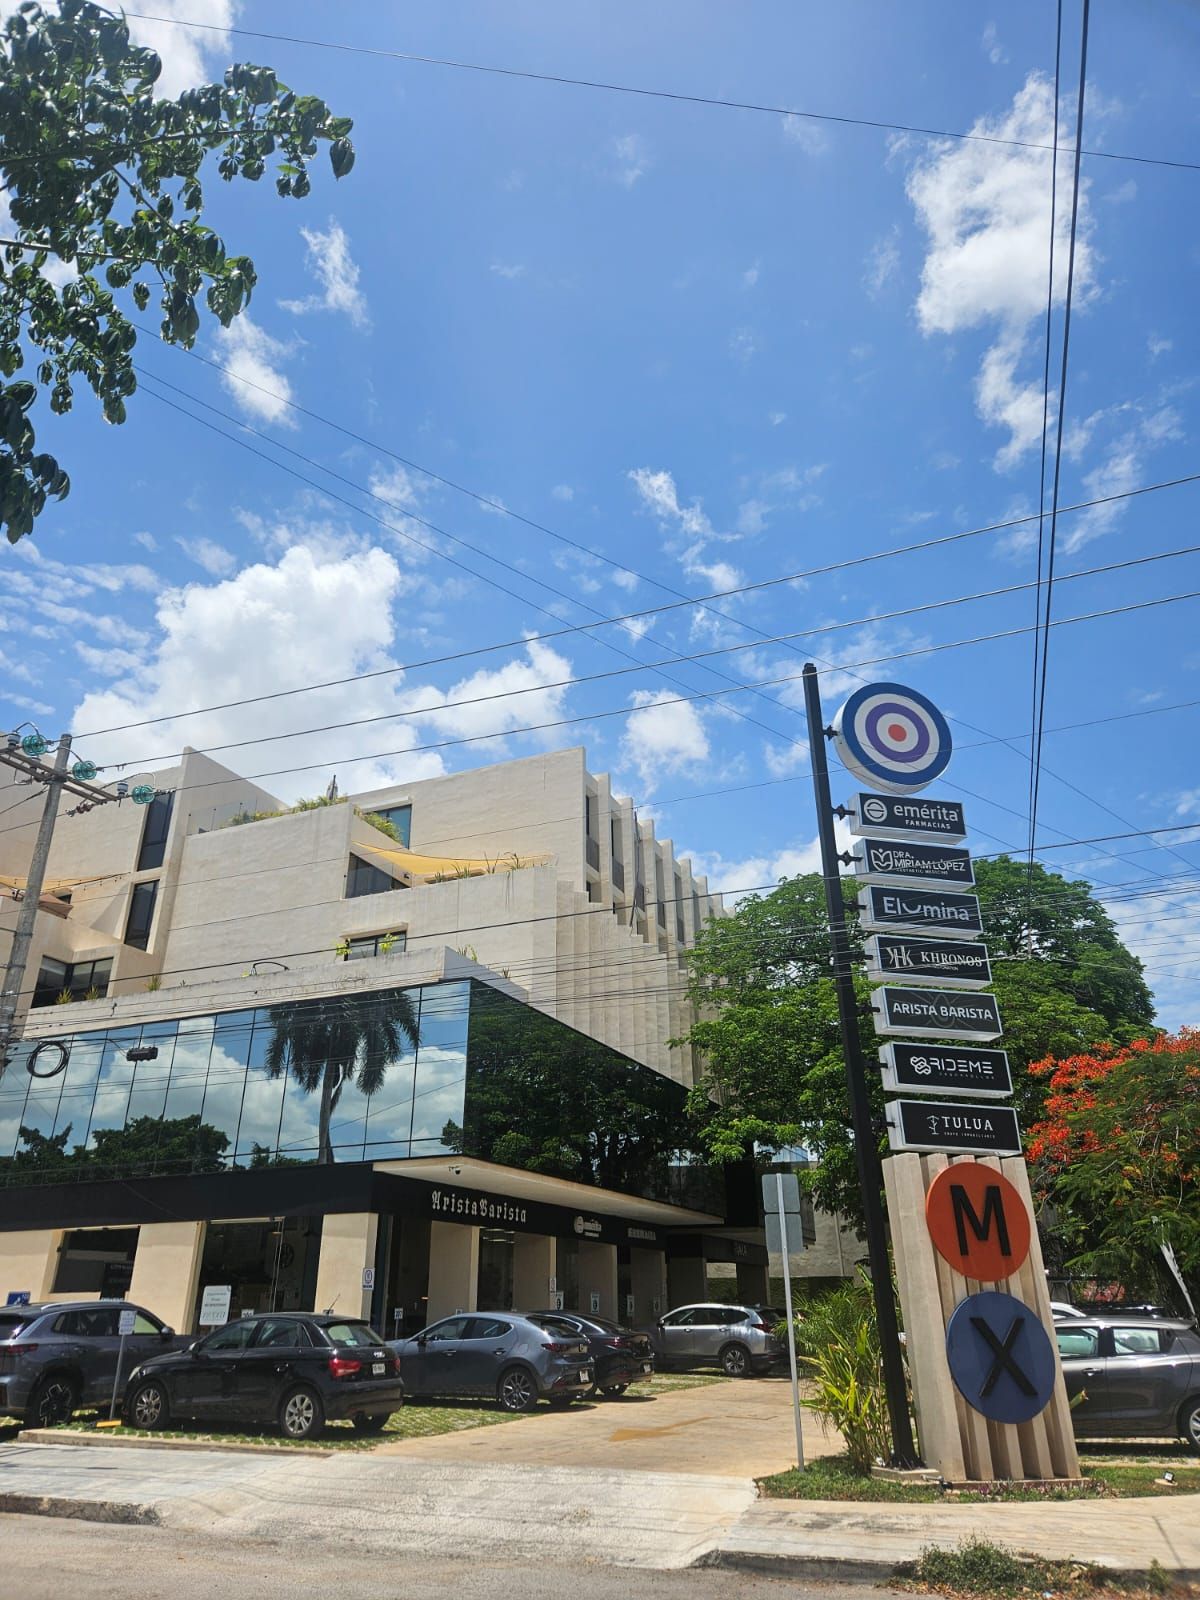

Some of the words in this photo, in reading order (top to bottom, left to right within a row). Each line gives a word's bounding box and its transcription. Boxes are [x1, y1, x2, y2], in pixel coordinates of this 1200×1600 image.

[893, 794, 959, 822] emérita
[904, 819, 951, 830] FARMACIAS
[892, 850, 914, 859] DRA.
[894, 858, 932, 869] MIRIAM
[920, 951, 983, 967] KHRONOS
[893, 1002, 938, 1016] ARISTA
[940, 1006, 994, 1020] BARISTA
[929, 1057, 994, 1074] RIDEME
[941, 1116, 994, 1131] TULUA
[950, 1185, 1012, 1256] M
[969, 1317, 1038, 1397] X
